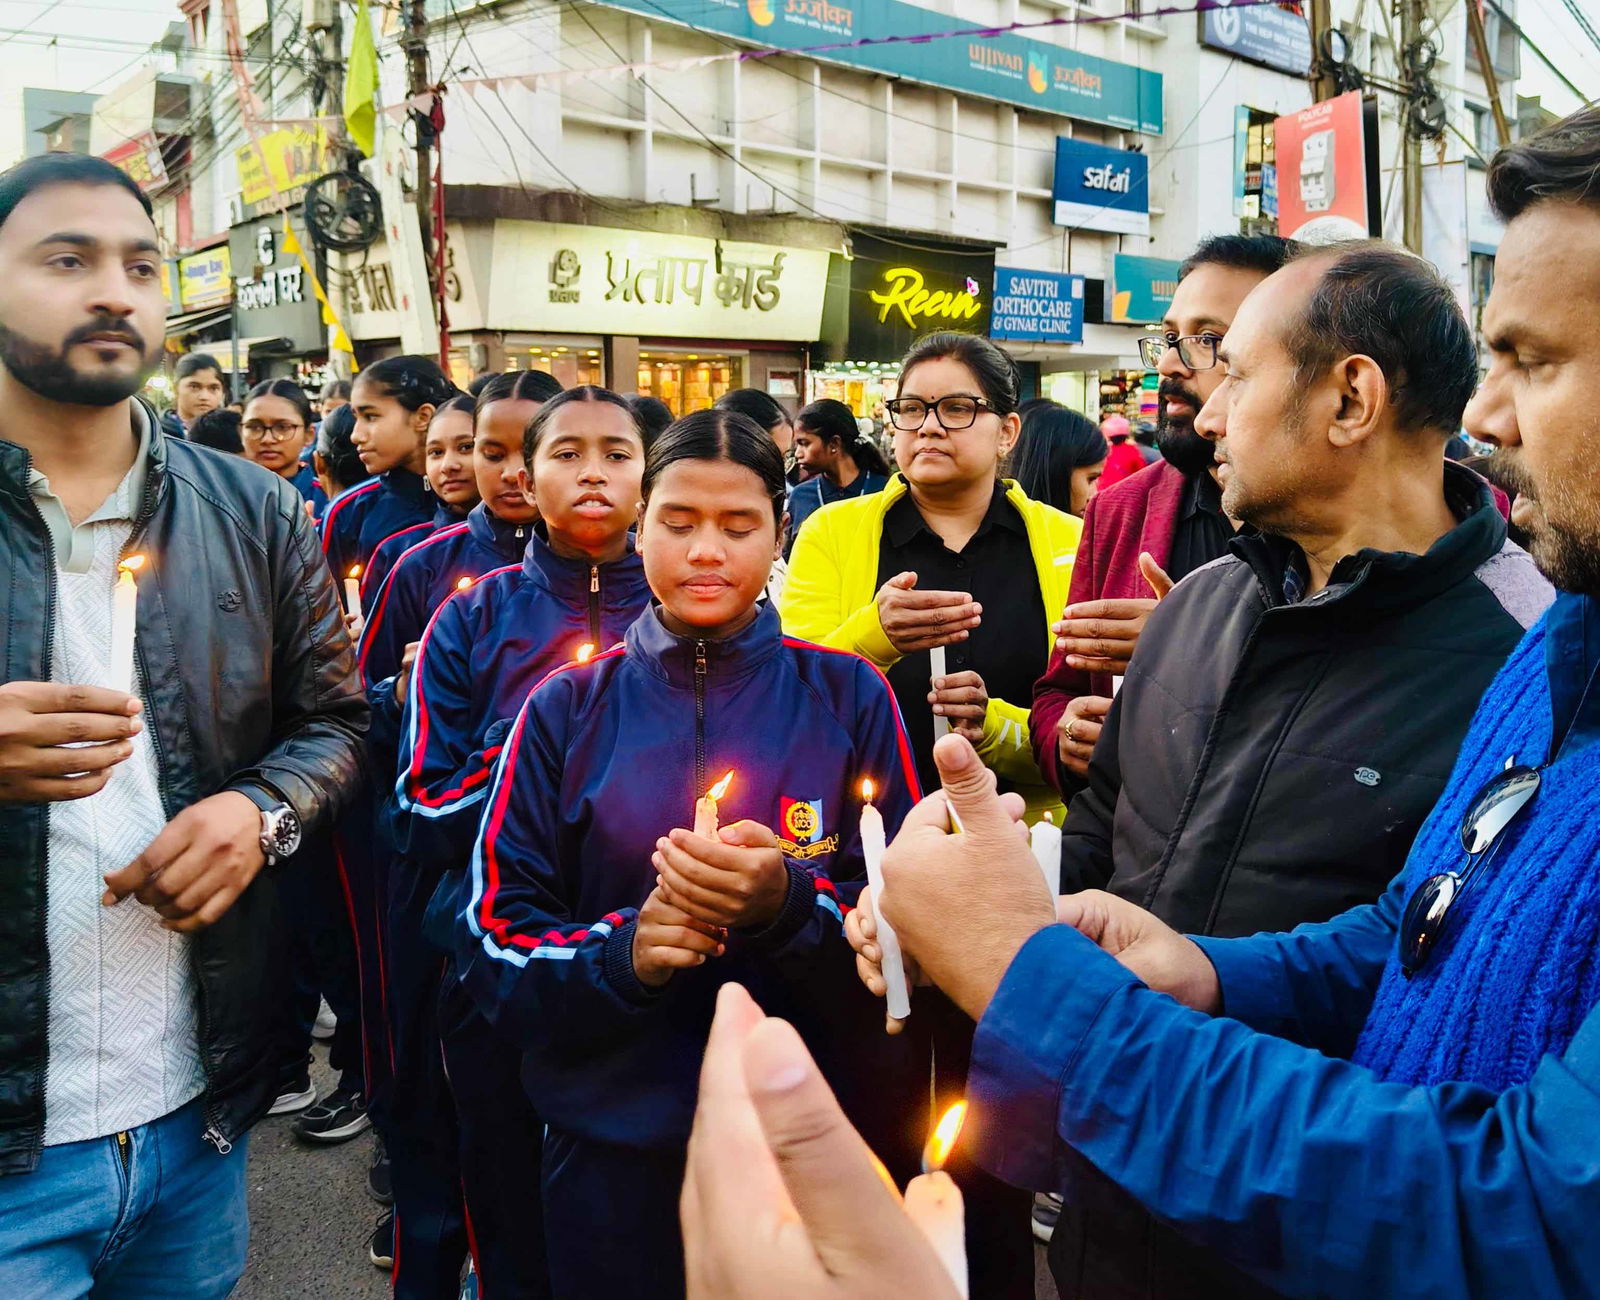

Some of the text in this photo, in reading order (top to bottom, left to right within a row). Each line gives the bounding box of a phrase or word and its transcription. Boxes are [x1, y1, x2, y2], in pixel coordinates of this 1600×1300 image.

[1083, 163, 1130, 193] safari
[603, 250, 708, 306] प्रताप
[1009, 276, 1059, 299] SAVITRI
[993, 296, 1072, 319] ORTHOCARE
[992, 315, 1072, 335] & GYNAE CLINIC
